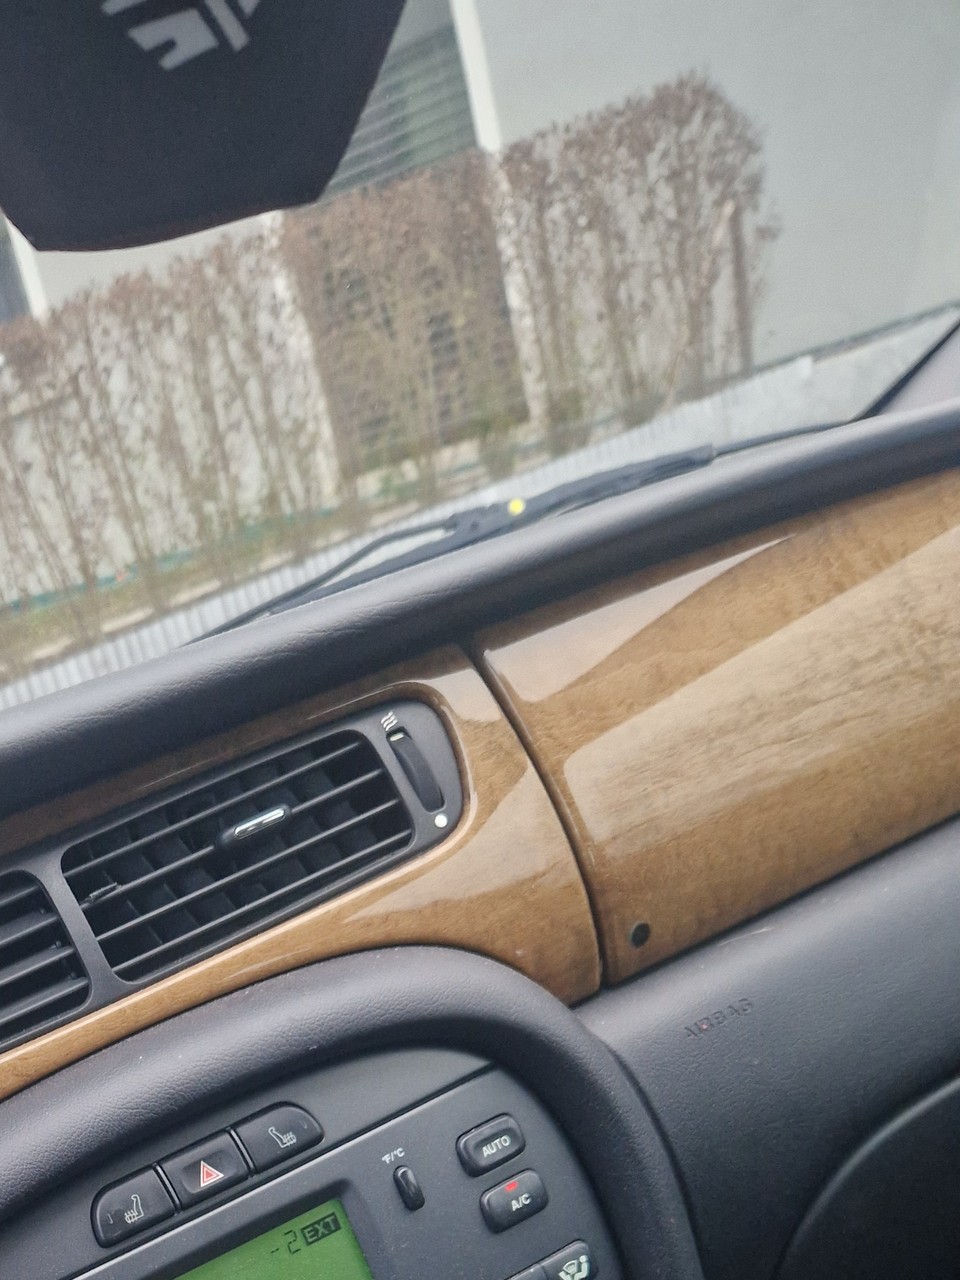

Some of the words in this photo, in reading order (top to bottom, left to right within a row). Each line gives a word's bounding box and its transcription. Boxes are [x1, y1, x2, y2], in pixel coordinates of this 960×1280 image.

[683, 998, 753, 1038] AIRBAG
[481, 1135, 512, 1158] AUTO
[511, 1193, 532, 1212] A/C
[303, 1213, 342, 1246] EXT
